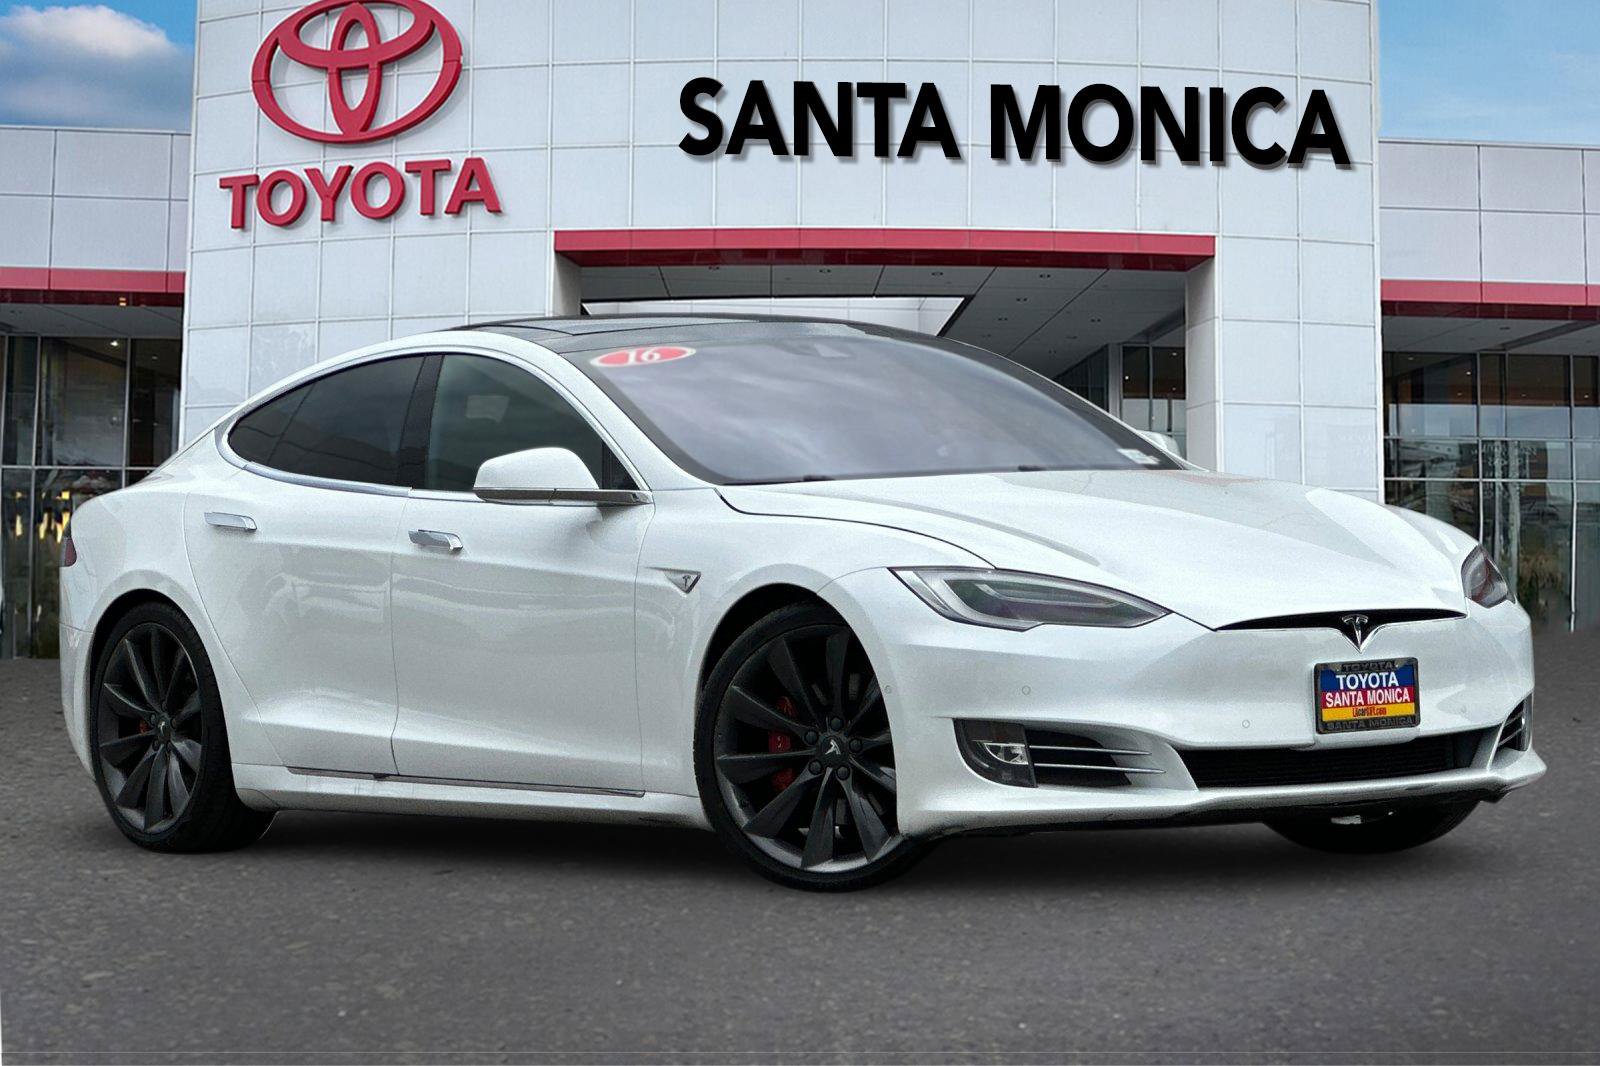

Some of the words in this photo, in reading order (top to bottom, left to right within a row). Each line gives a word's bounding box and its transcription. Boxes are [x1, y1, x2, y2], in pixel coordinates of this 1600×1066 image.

[678, 76, 961, 159] SANTA
[990, 83, 1352, 169] MONICA
[219, 157, 502, 229] TOYOTA
[626, 347, 661, 363] 16
[1342, 661, 1394, 671] TOYOTA
[1336, 671, 1399, 690] TOYOTA
[1325, 691, 1364, 707] SANTA
[1367, 688, 1410, 704] MONICA
